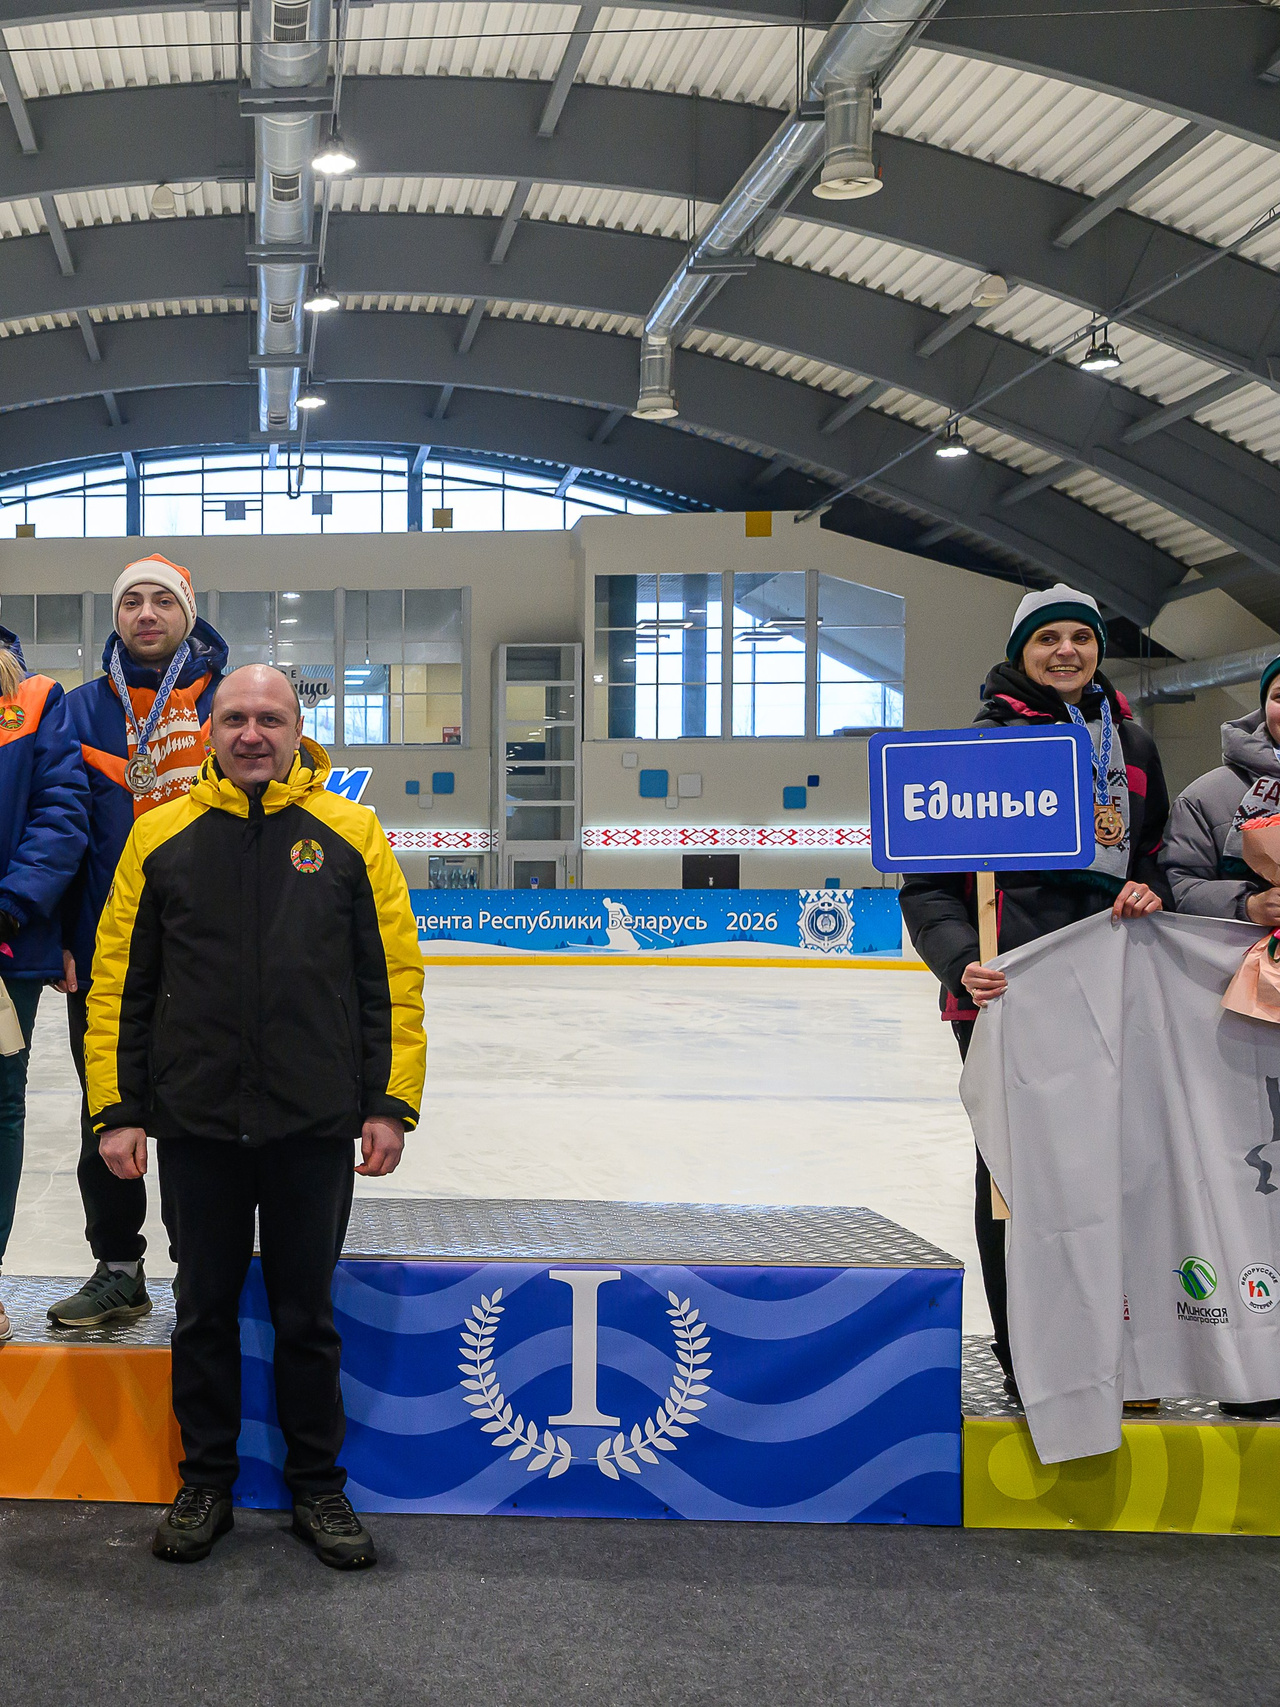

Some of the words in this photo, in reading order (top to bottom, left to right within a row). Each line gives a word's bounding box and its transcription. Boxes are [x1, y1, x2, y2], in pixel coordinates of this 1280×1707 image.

[903, 780, 1059, 822] Единые
[416, 914, 473, 933] дента
[478, 910, 602, 935] Республики
[608, 911, 708, 935] Беларусь
[725, 912, 778, 931] 2026
[1240, 1267, 1279, 1286] БЕЛОРУССКИЕ
[1177, 1301, 1228, 1318] Минская
[548, 1270, 621, 1427] I
